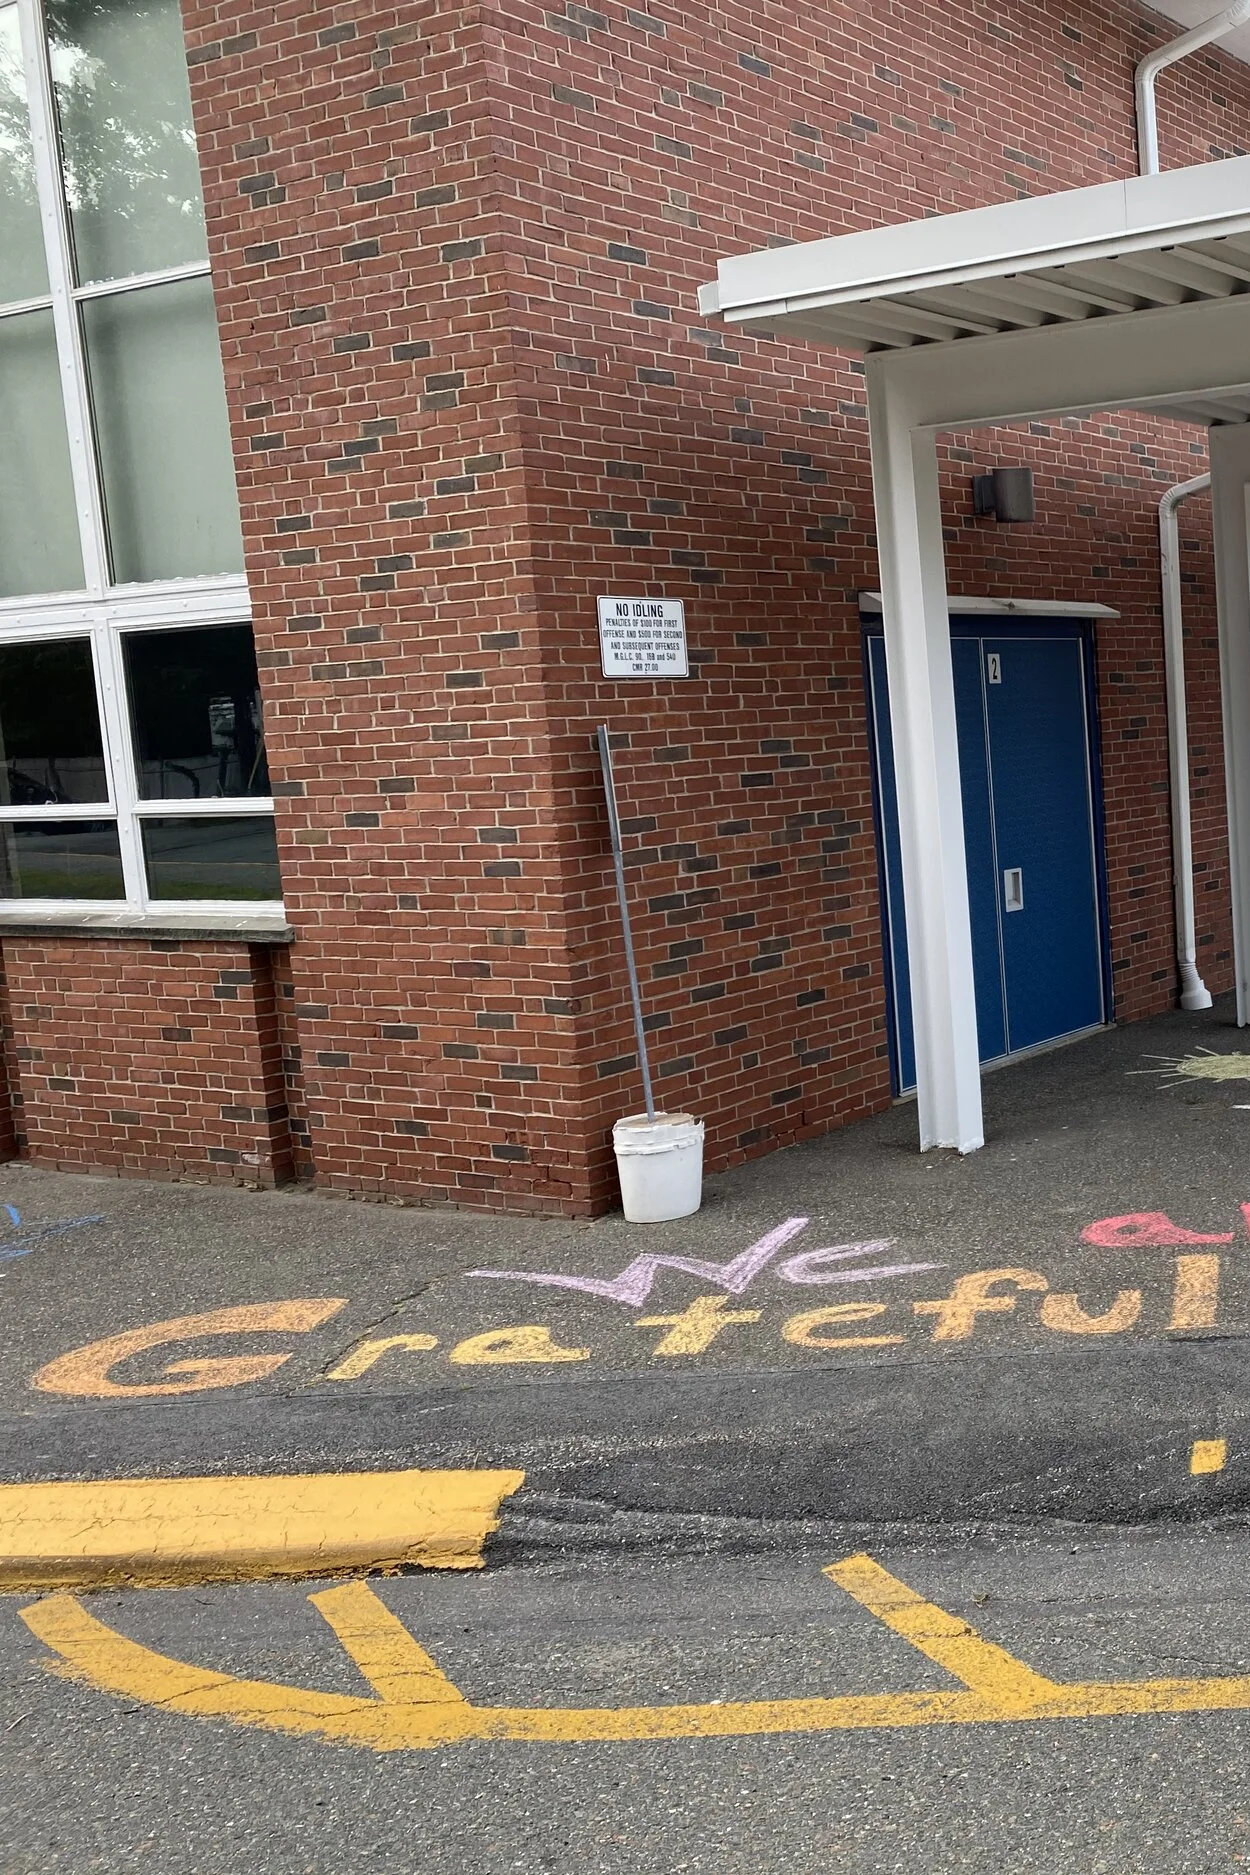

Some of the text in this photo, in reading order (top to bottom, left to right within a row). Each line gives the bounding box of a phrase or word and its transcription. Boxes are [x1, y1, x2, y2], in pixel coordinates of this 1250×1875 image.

[616, 603, 664, 617] NO IDLING
[606, 618, 677, 628] PENALTIES OF $100 FOR FIRST
[603, 630, 682, 639] OFFENSE AND $500 FOR SECOND
[610, 642, 621, 650] AND
[622, 642, 653, 651] SUBSEQUENT
[992, 657, 998, 679] 2
[464, 1217, 949, 1307] We
[31, 1252, 1220, 1398] Grateful
